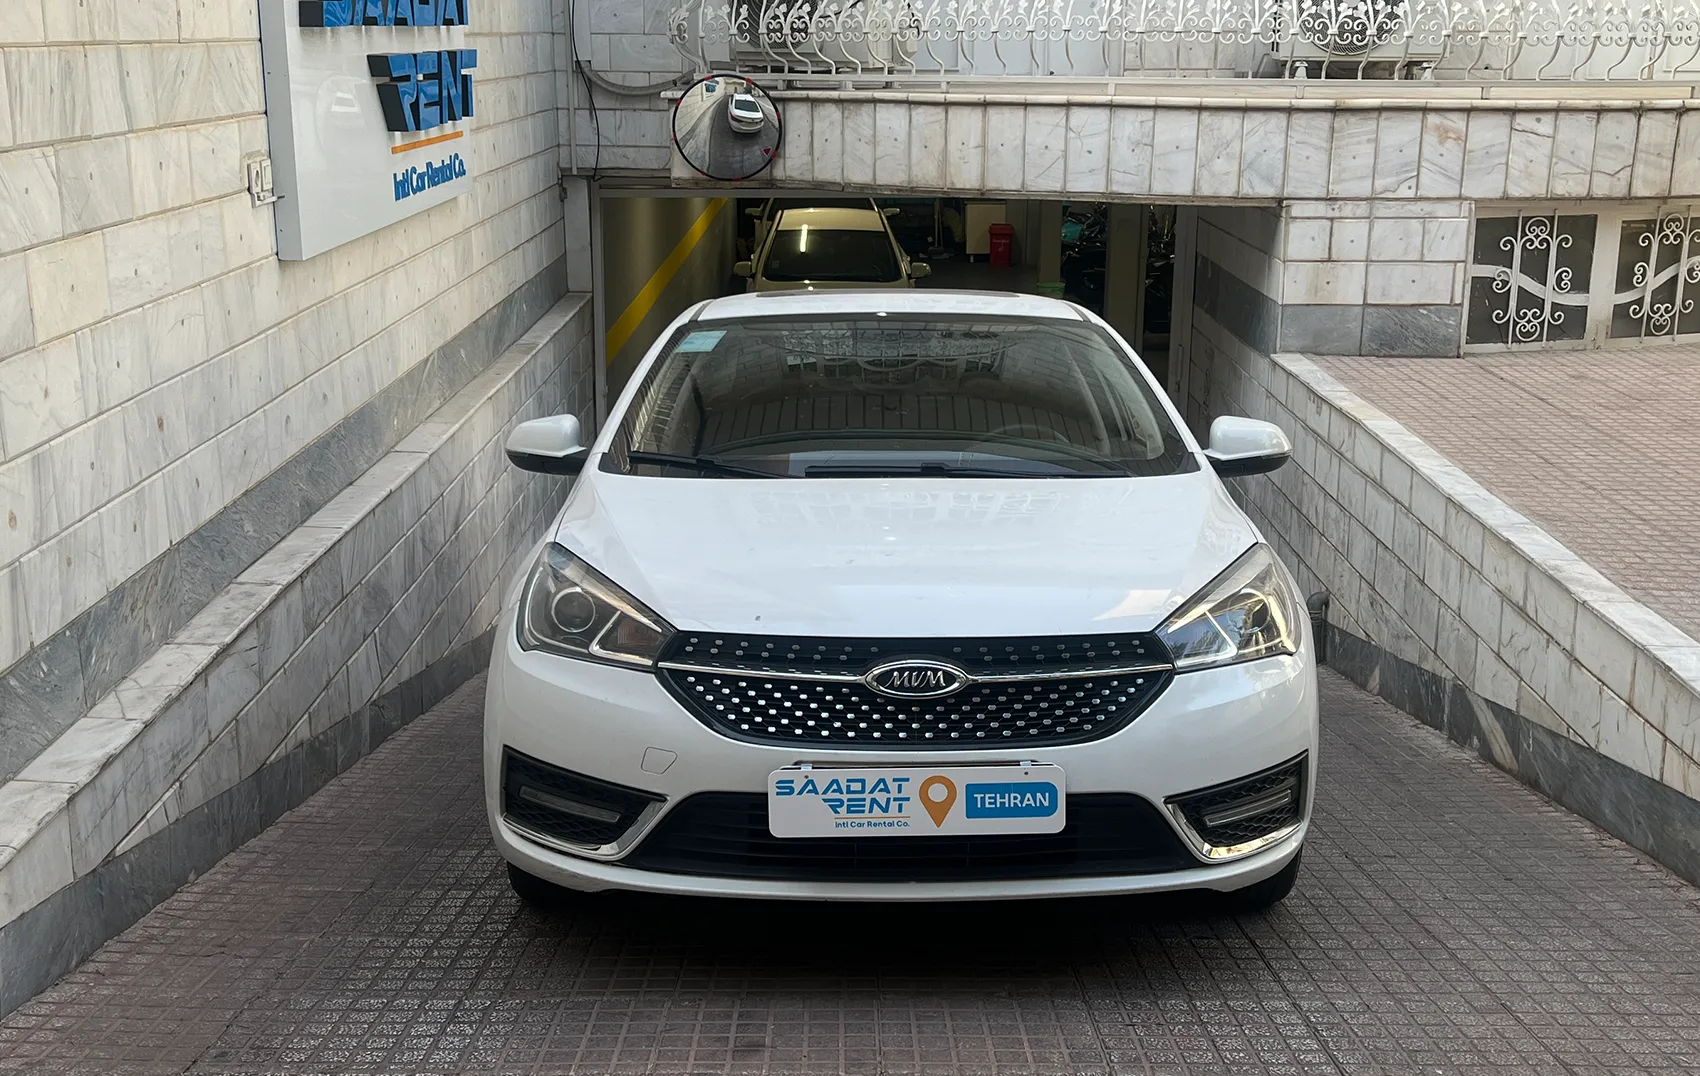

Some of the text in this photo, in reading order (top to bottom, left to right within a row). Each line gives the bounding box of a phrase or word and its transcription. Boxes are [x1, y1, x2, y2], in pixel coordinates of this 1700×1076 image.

[371, 49, 477, 131] RENT
[410, 165, 427, 195] Car
[426, 154, 454, 189] Rental
[453, 152, 467, 179] Co.
[884, 671, 946, 687] MVM
[775, 777, 910, 796] SAADAT
[821, 797, 911, 814] RENT
[973, 792, 1050, 809] TEHRAN
[850, 820, 865, 828] Car
[867, 820, 895, 828] Rental
[896, 820, 910, 828] Co.
